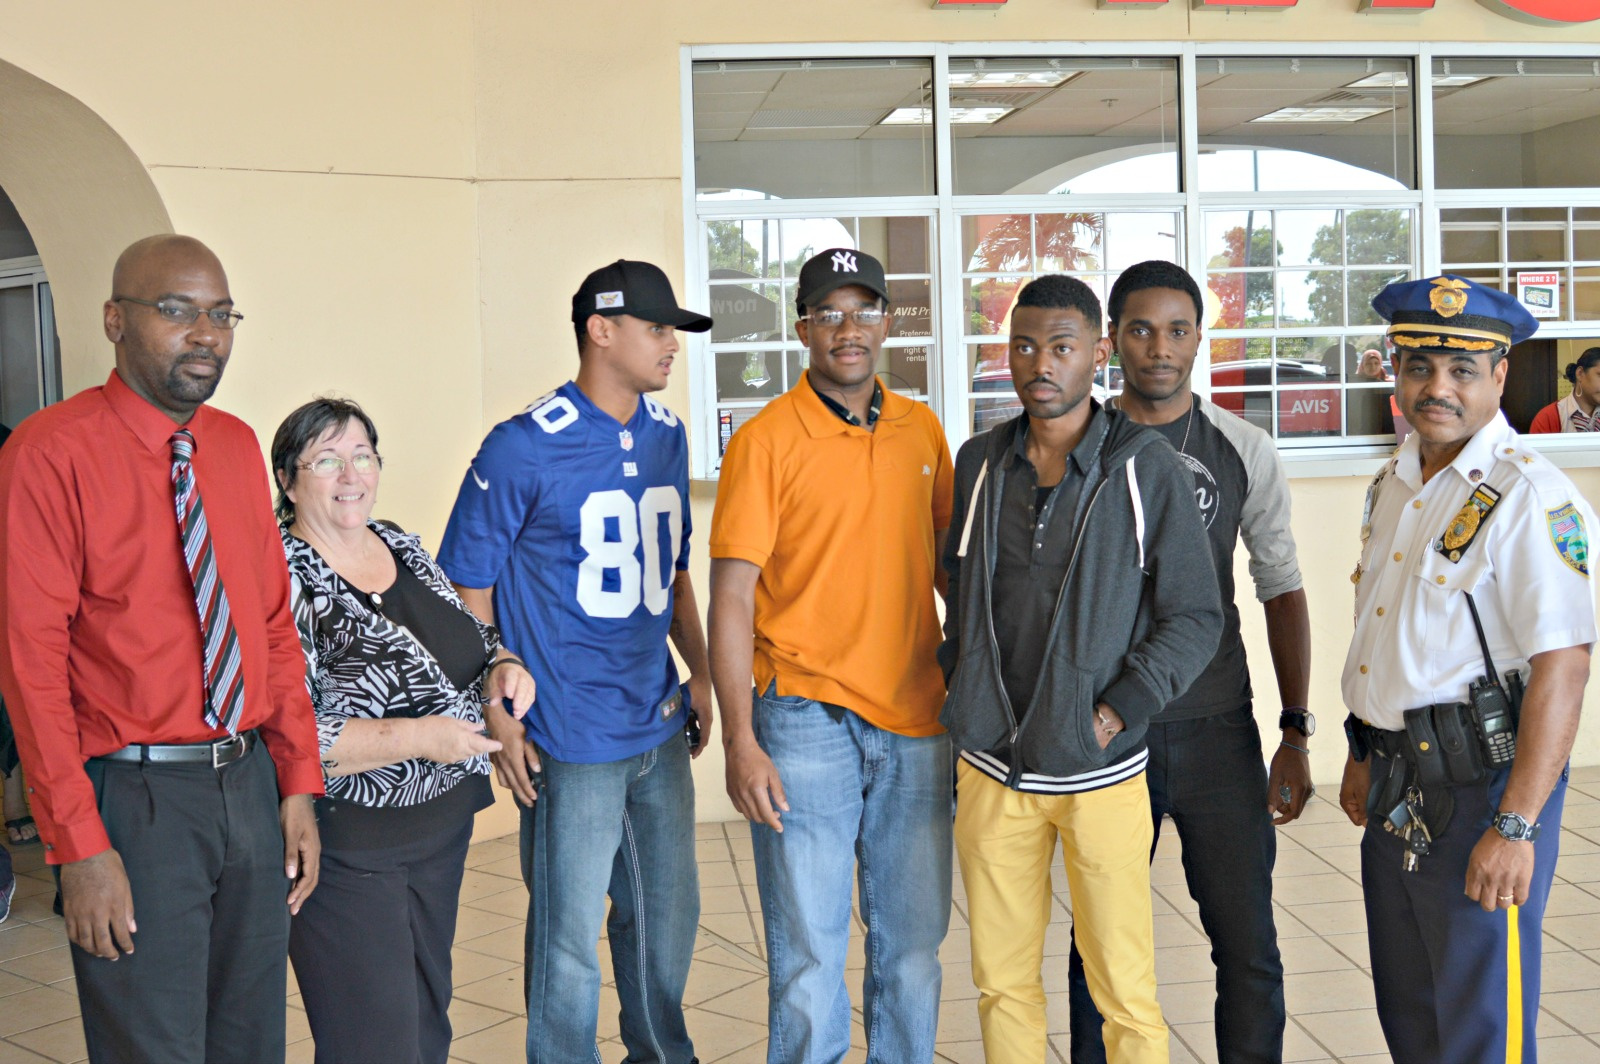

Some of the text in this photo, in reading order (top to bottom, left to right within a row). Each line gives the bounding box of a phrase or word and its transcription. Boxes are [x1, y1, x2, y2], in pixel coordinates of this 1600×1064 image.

[831, 251, 859, 273] NY
[894, 306, 918, 316] AVIS
[903, 346, 921, 355] right
[1291, 399, 1330, 414] AVIS
[577, 485, 682, 618] 80
